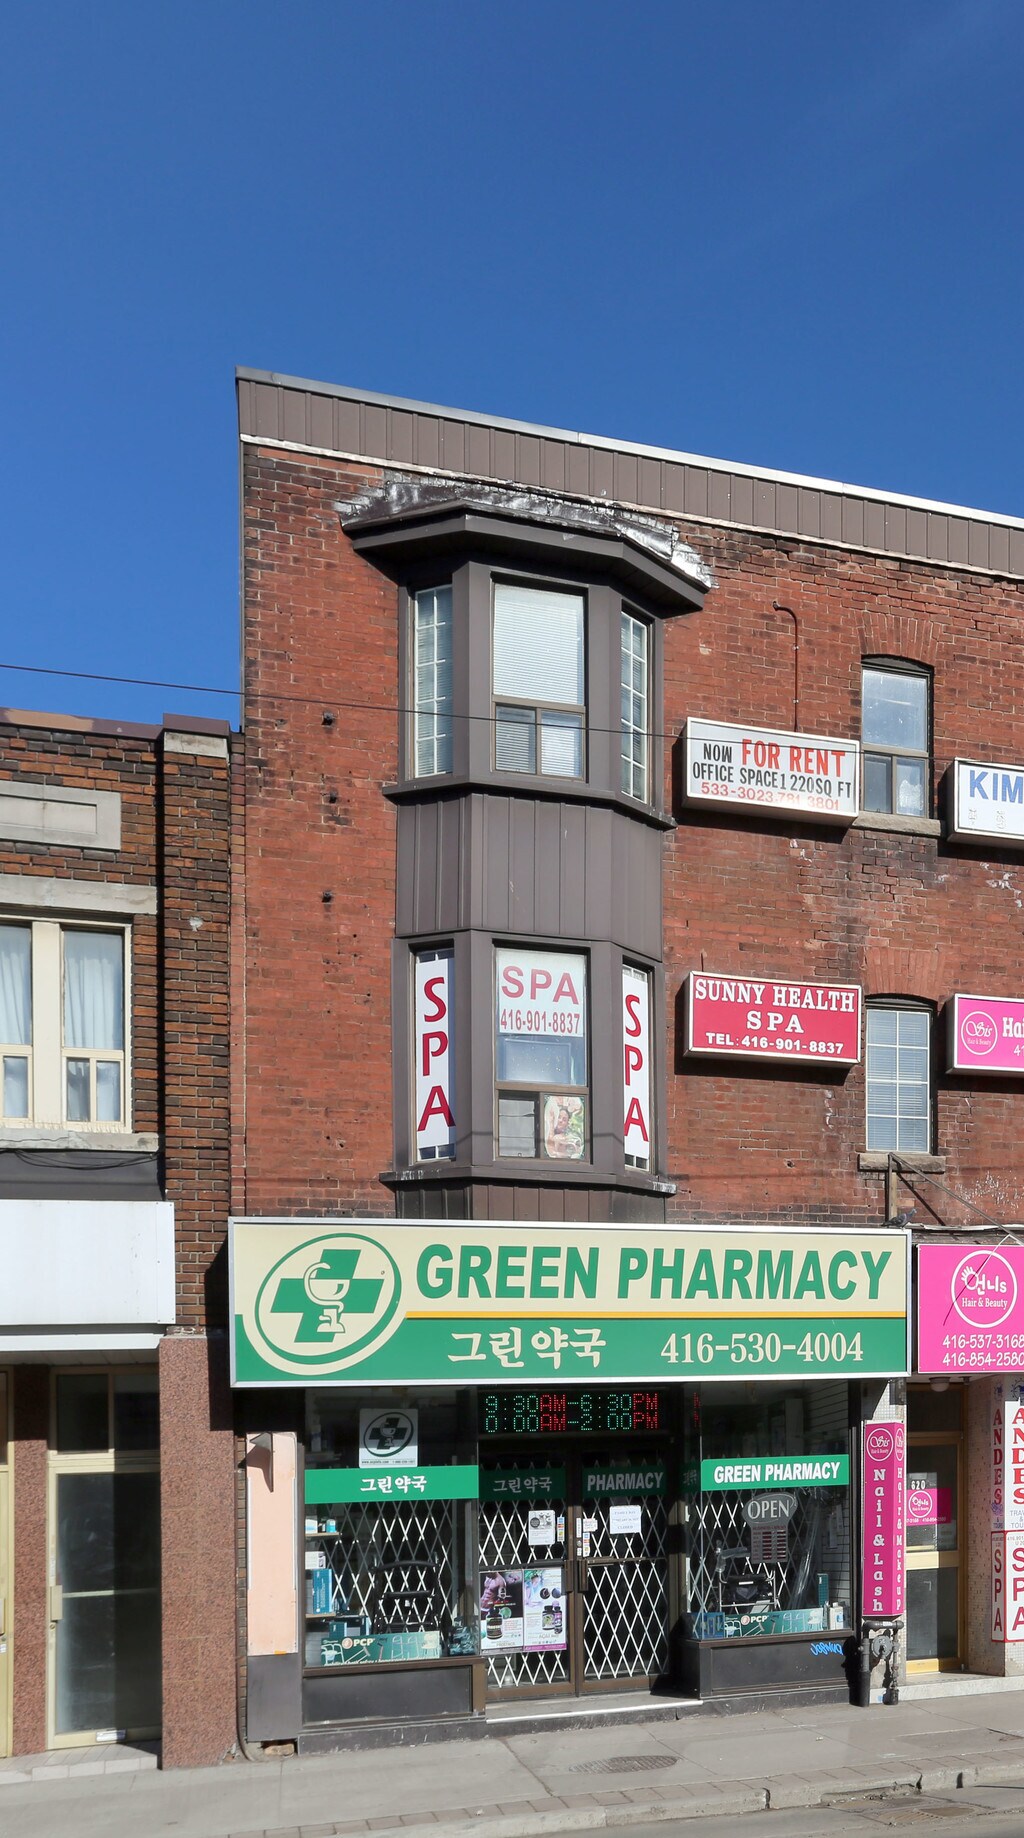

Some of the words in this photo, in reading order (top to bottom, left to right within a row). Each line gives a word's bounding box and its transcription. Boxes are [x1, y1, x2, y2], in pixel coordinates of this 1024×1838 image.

[703, 743, 732, 763] NOW
[742, 738, 780, 769] FOR
[789, 745, 845, 777] RENT
[693, 762, 734, 783] OFFICE
[838, 781, 852, 798] FT
[502, 966, 579, 1005] SPA
[695, 979, 765, 1005] SUNNY
[773, 985, 855, 1012] HEALTH
[501, 1008, 580, 1034] 416-901-8837
[747, 1010, 804, 1033] SPA
[965, 1020, 993, 1037] Sis
[417, 976, 456, 1131] SPA
[623, 994, 649, 1142] SPA
[416, 1243, 600, 1299] GREEN
[617, 1247, 892, 1300] PHARMACY
[962, 1298, 977, 1307] Hair
[978, 1297, 984, 1307] &
[985, 1297, 1008, 1310] Beauty
[447, 1326, 606, 1370] 그린약국
[661, 1332, 863, 1364] 416-530-4004
[714, 1464, 761, 1483] GREEN
[765, 1461, 840, 1482] PHARMACY
[993, 1408, 1003, 1505] ANDES
[360, 1475, 427, 1493] 그린약국
[587, 1472, 664, 1491] PHARMACY
[911, 1480, 926, 1490] 620
[748, 1499, 790, 1520] OPEN
[873, 1469, 886, 1527] Nail
[872, 1534, 885, 1546] &
[872, 1553, 884, 1611] Lash
[994, 1549, 1003, 1632] SPA
[750, 1615, 768, 1623] PCP
[353, 1637, 374, 1646] PCP
